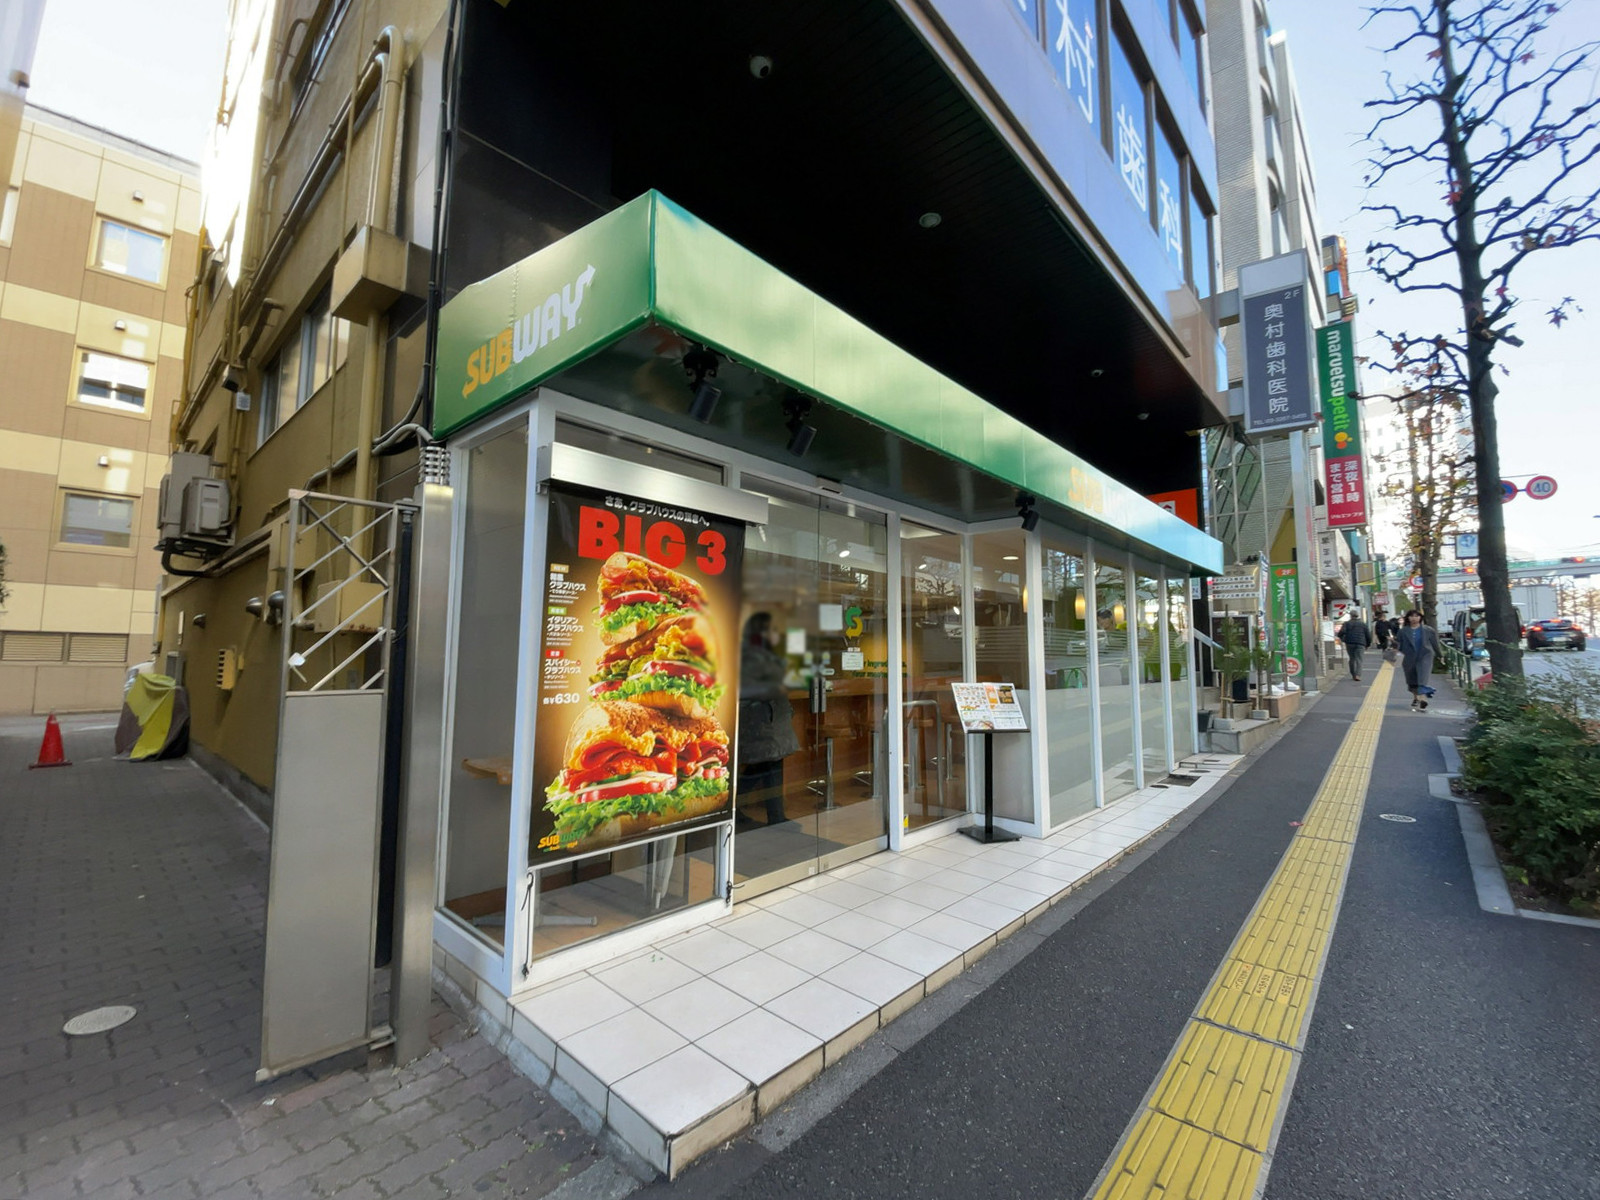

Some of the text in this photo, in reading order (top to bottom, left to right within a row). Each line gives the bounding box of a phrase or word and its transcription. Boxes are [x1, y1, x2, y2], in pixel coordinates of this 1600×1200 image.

[1284, 289, 1300, 300] 2F
[462, 264, 596, 399] SUBWAY
[1264, 303, 1289, 414] 奥村歯科医院
[1329, 462, 1345, 505] まで営業
[1344, 460, 1360, 503] 深夜1時
[1533, 481, 1551, 493] 40
[578, 505, 727, 576] BIG 3
[549, 581, 587, 591] クラブハウス
[547, 616, 579, 625] イタリアン
[547, 624, 584, 633] クラブハウス
[545, 658, 577, 667] スパイシー
[544, 667, 581, 675] クラブハウス
